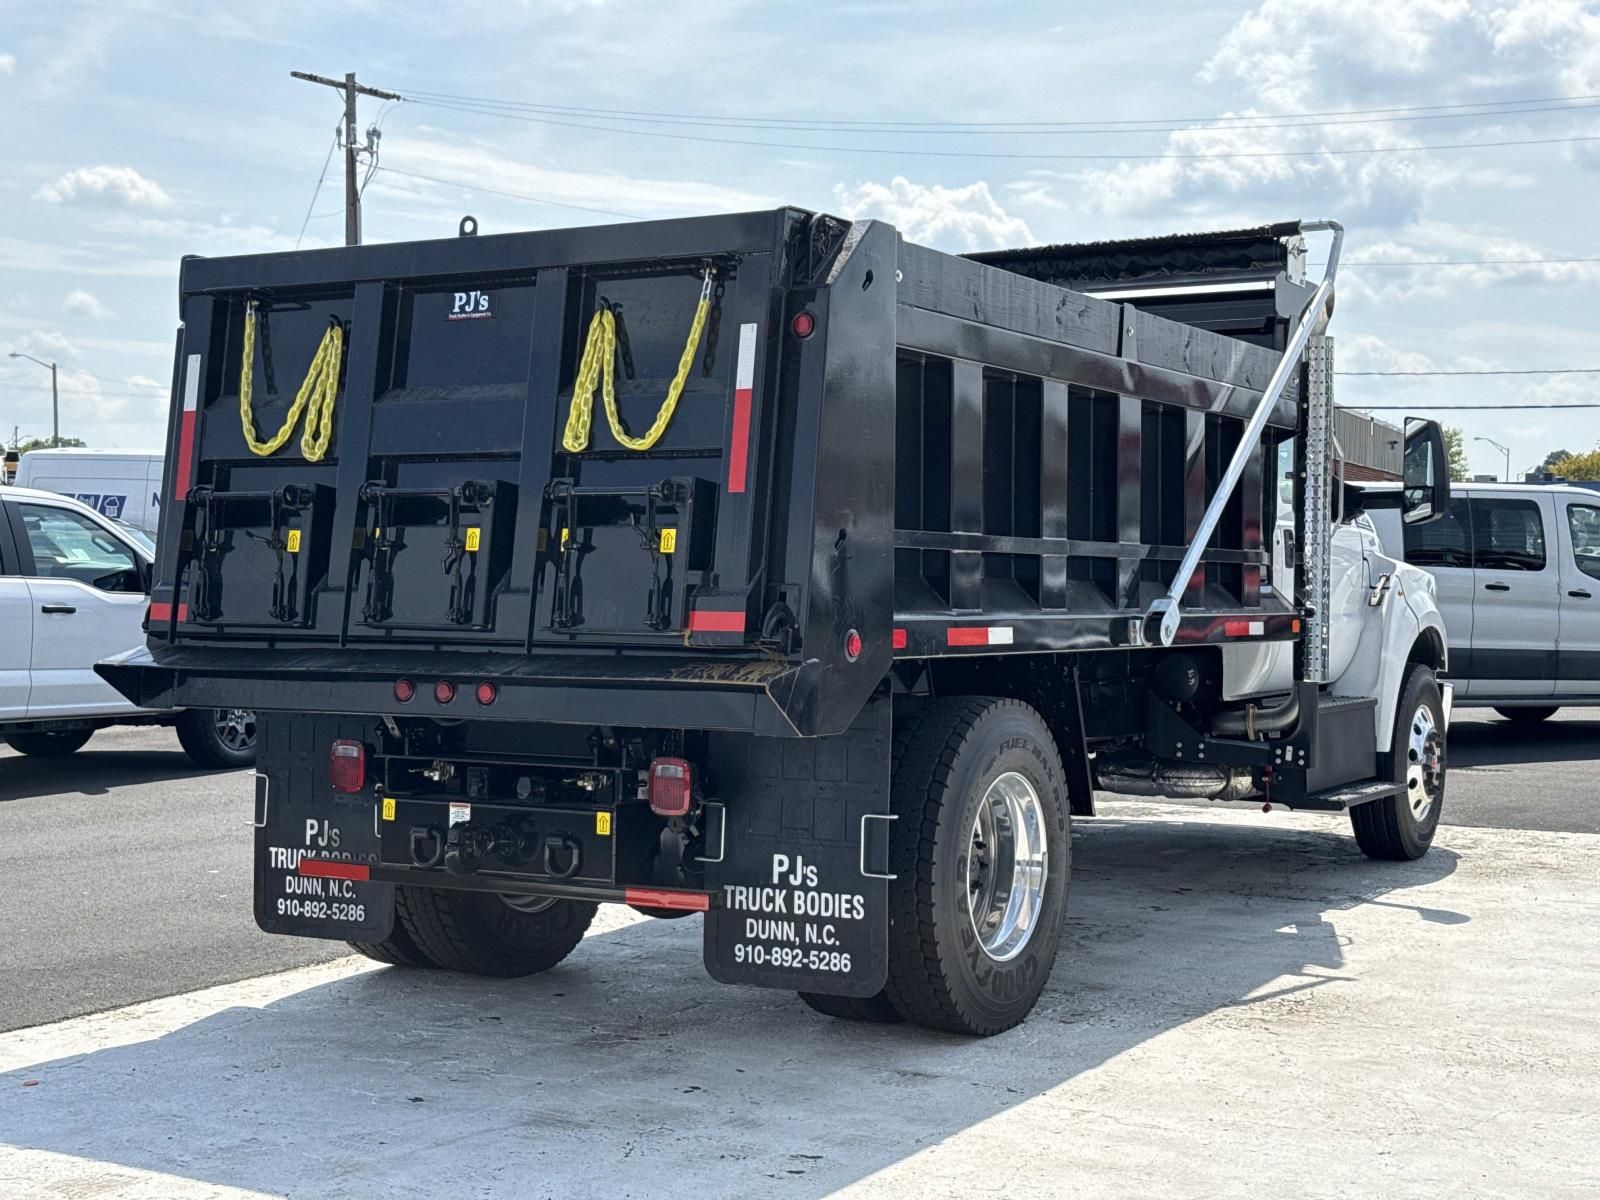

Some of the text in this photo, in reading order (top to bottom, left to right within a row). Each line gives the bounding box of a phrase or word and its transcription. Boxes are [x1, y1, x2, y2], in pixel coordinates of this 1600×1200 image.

[453, 290, 489, 312] PJ's
[286, 876, 357, 898] DUNN, N.C.
[277, 899, 365, 922] 910-892-5286
[724, 885, 865, 920] TRUCK BODIES
[746, 918, 840, 946] DUNN, N.C.
[734, 943, 851, 973] 910-892-5286
